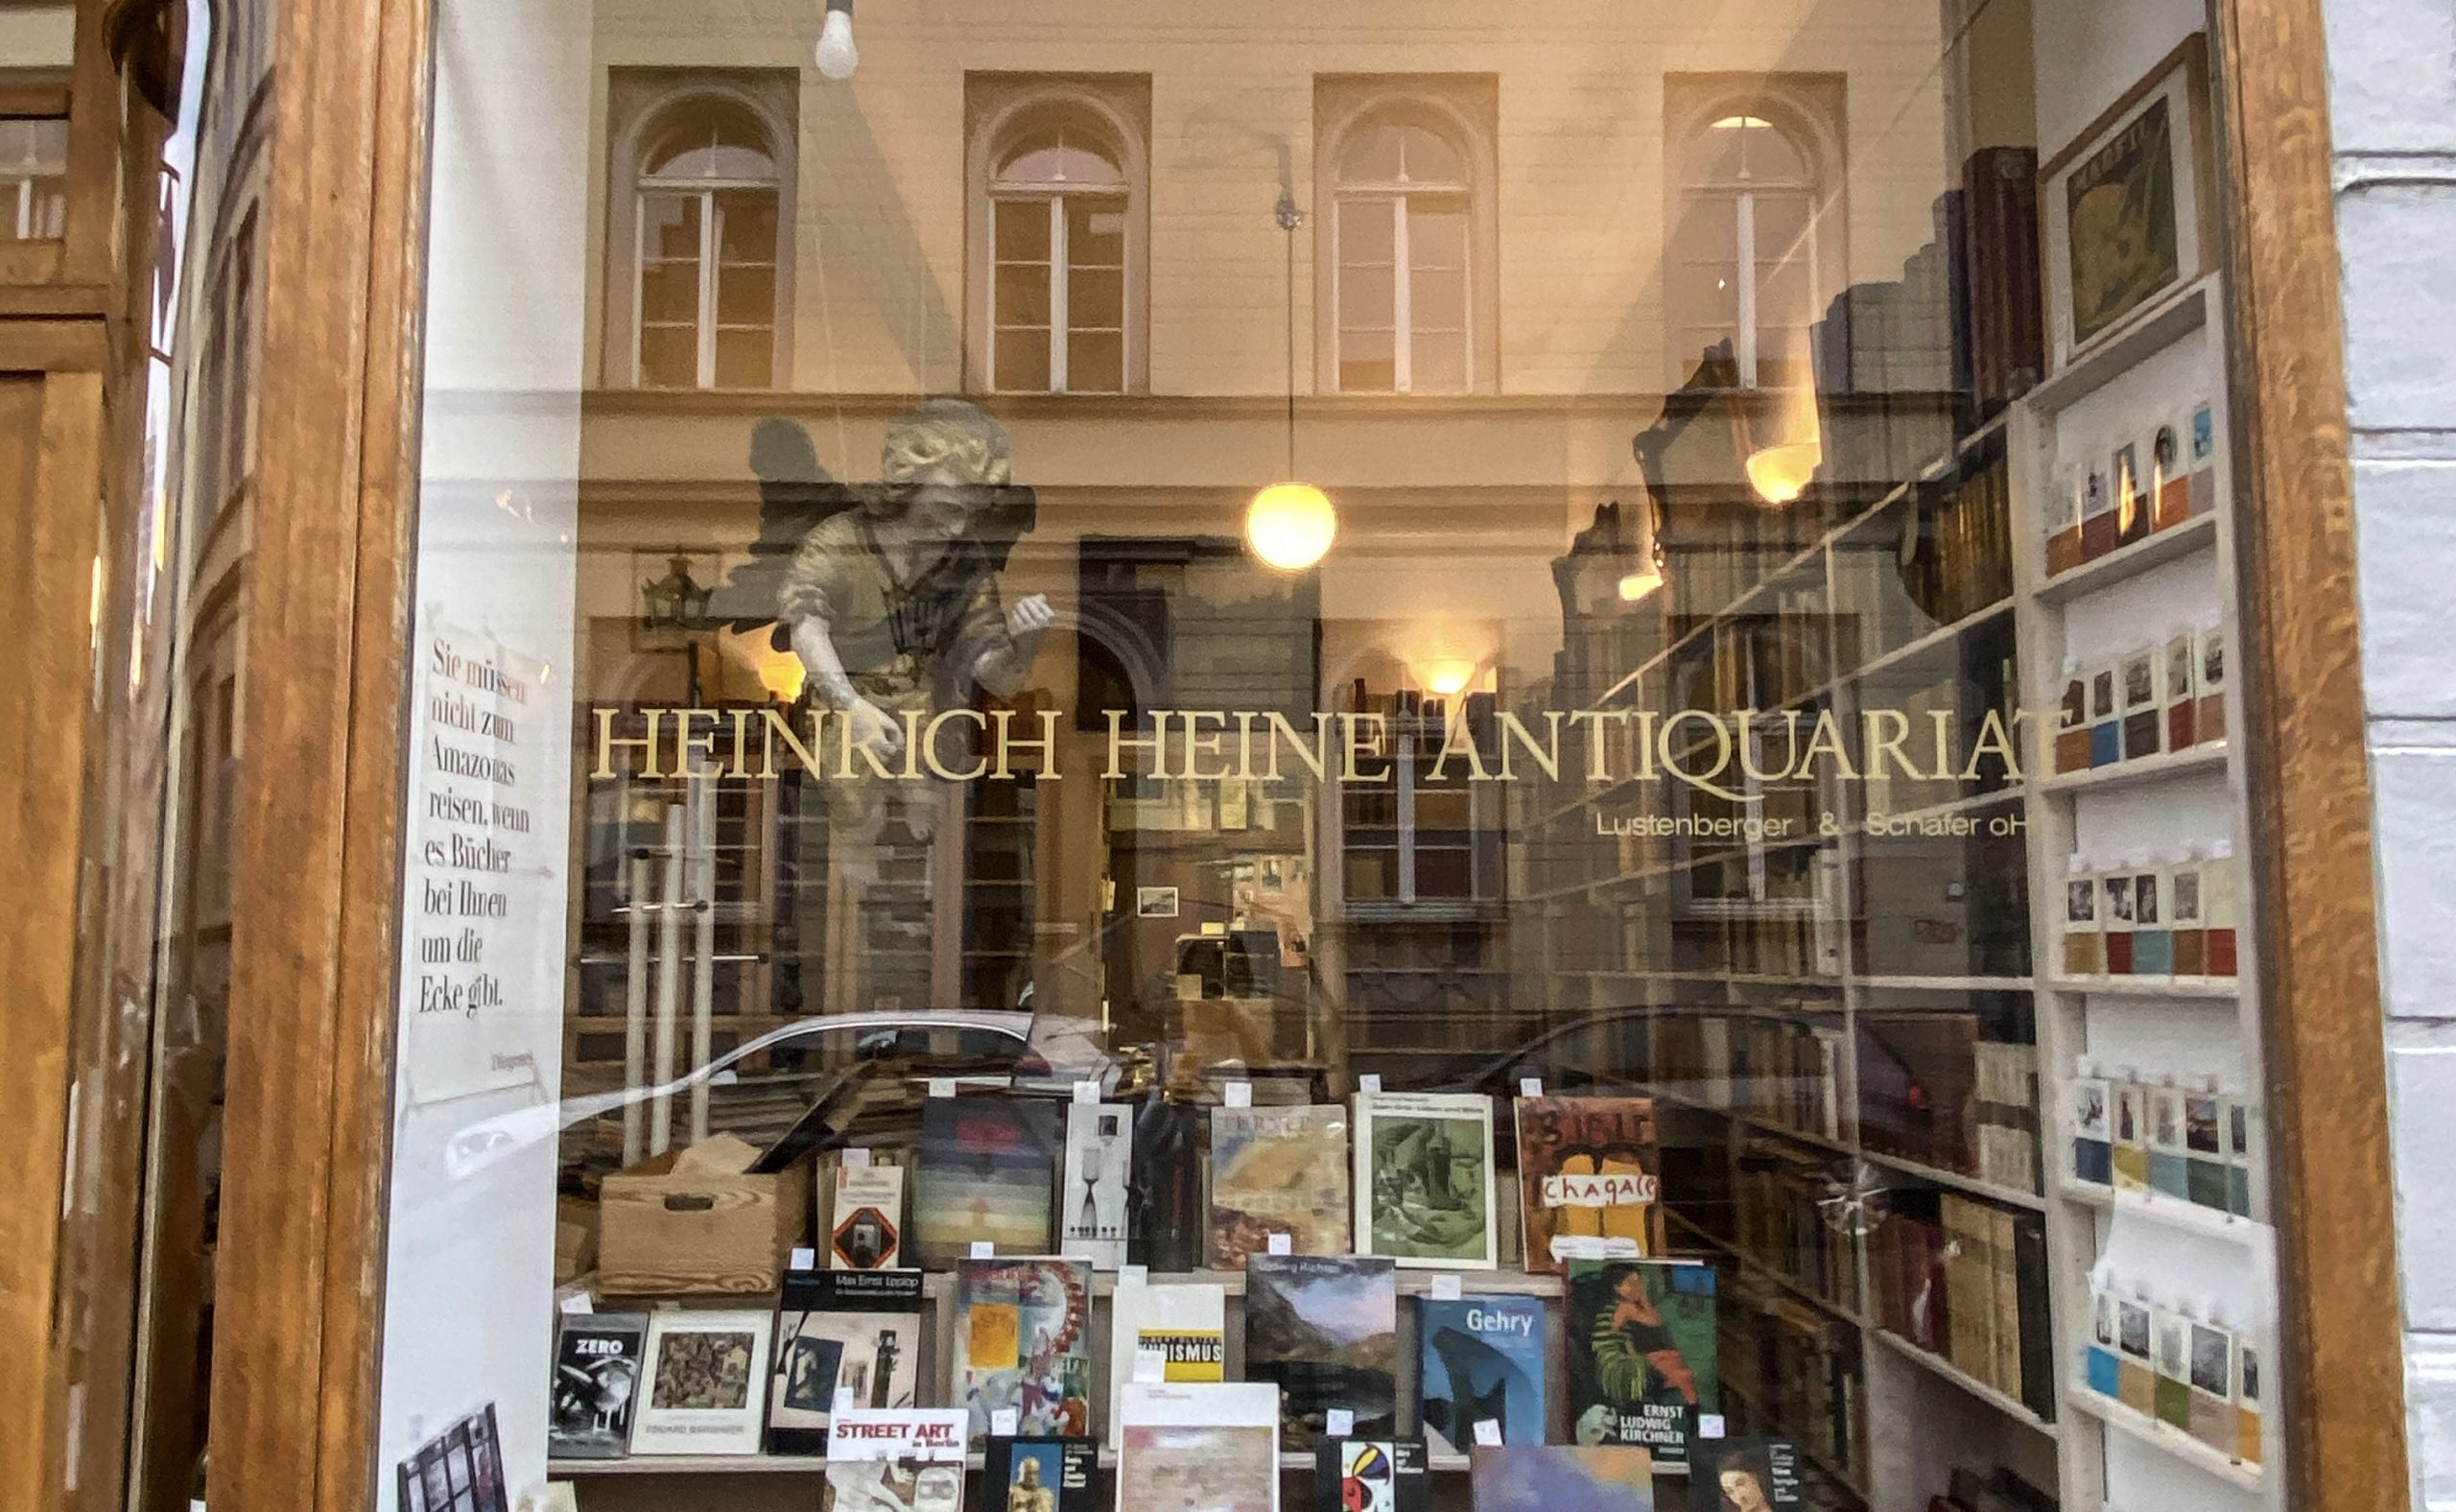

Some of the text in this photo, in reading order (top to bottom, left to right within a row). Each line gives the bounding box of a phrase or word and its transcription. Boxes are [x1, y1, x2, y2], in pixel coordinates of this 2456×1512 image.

[433, 637, 529, 706] Sie müssen
[432, 690, 476, 733] nicht
[432, 734, 515, 787] Amazonas
[589, 708, 2074, 800] HEINRICH HEINE ANTIQUARIAT
[492, 802, 531, 833] wenn
[1595, 812, 1793, 842] Lustenberger
[1820, 812, 1839, 837] &
[425, 832, 511, 873] es Bücher
[423, 877, 508, 918] bei Ihnen
[421, 927, 484, 963] um die
[418, 973, 504, 1020] Ecke gibt.
[1466, 1308, 1533, 1337] Gehry
[575, 1338, 624, 1355] ZERO
[1619, 1415, 1671, 1430] LUDWIG
[1643, 1404, 1684, 1419] ERNST
[837, 1424, 955, 1438] STREET ART
[1619, 1428, 1685, 1445] KIRCHNER
